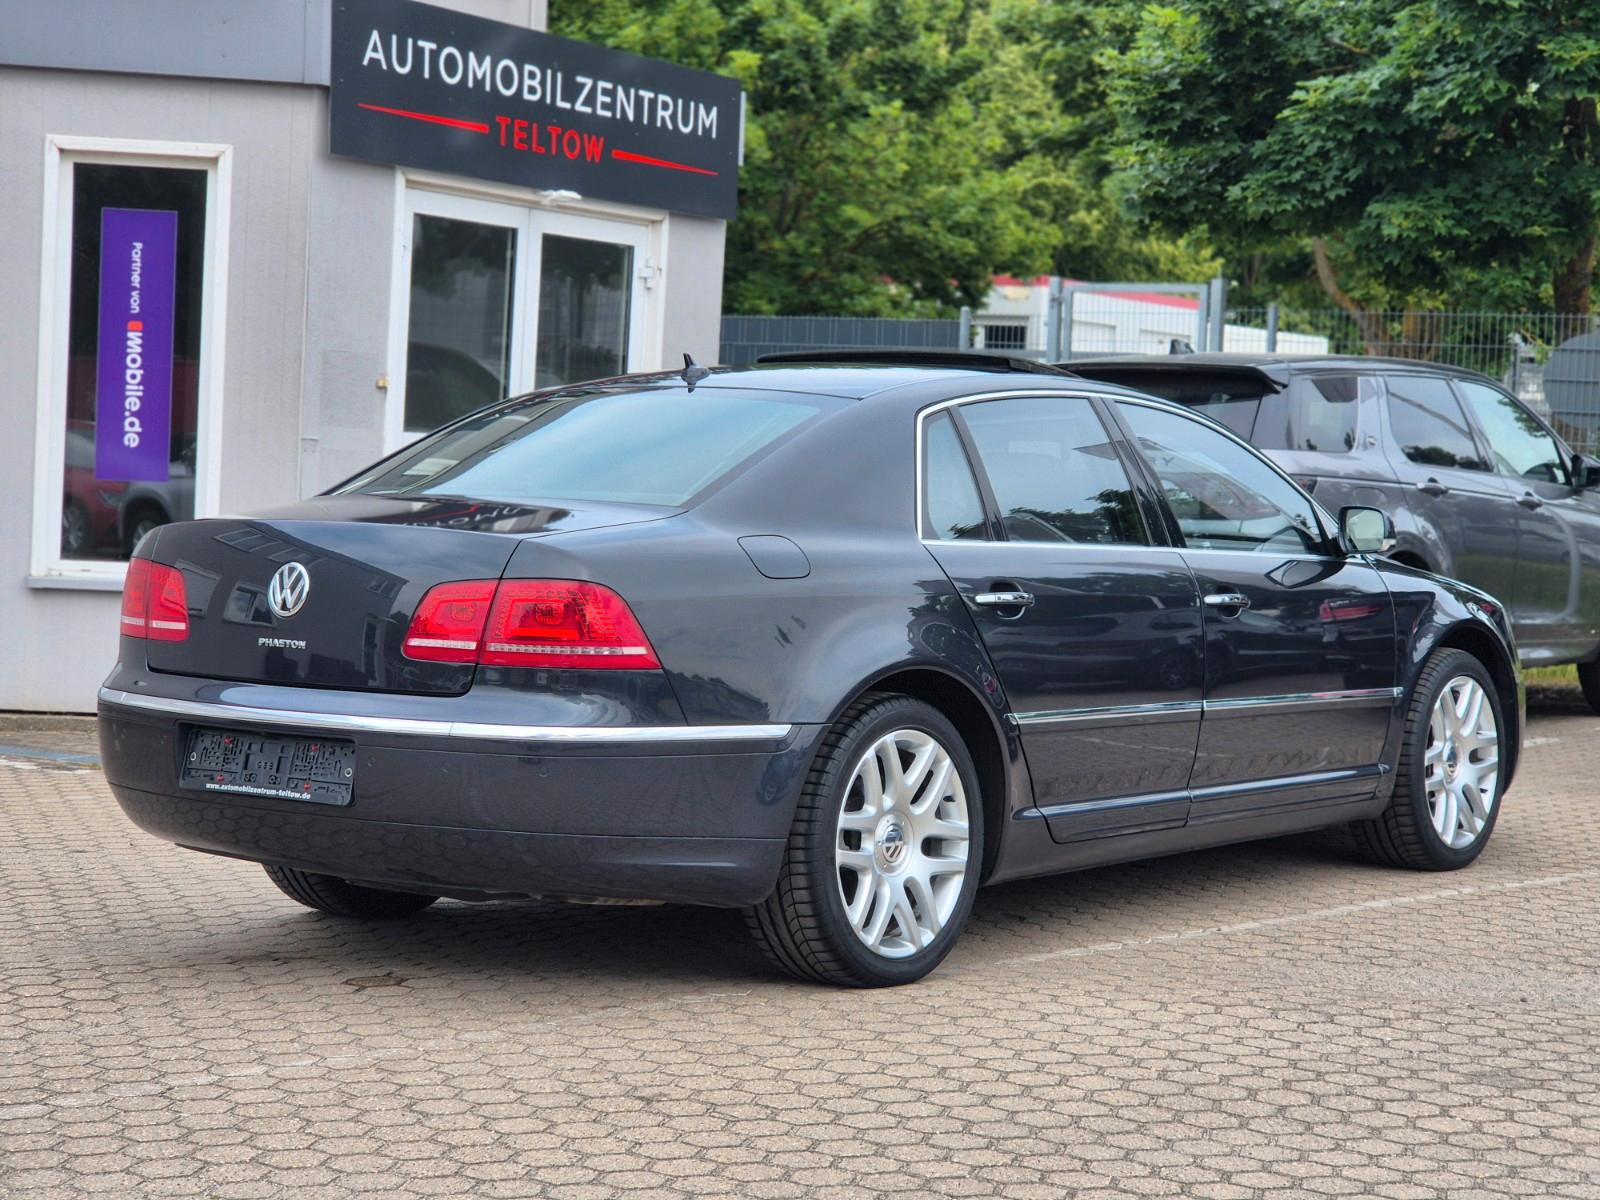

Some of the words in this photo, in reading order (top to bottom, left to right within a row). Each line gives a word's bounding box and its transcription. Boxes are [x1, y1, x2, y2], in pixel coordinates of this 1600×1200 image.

[362, 29, 718, 139] AUTOMOBILZENTRUM
[495, 115, 605, 163] TELTOW
[130, 242, 143, 288] Partner
[130, 290, 140, 314] von
[124, 331, 144, 448] mobile.de
[205, 783, 312, 800] www.automobilzentrum-teltow.de
